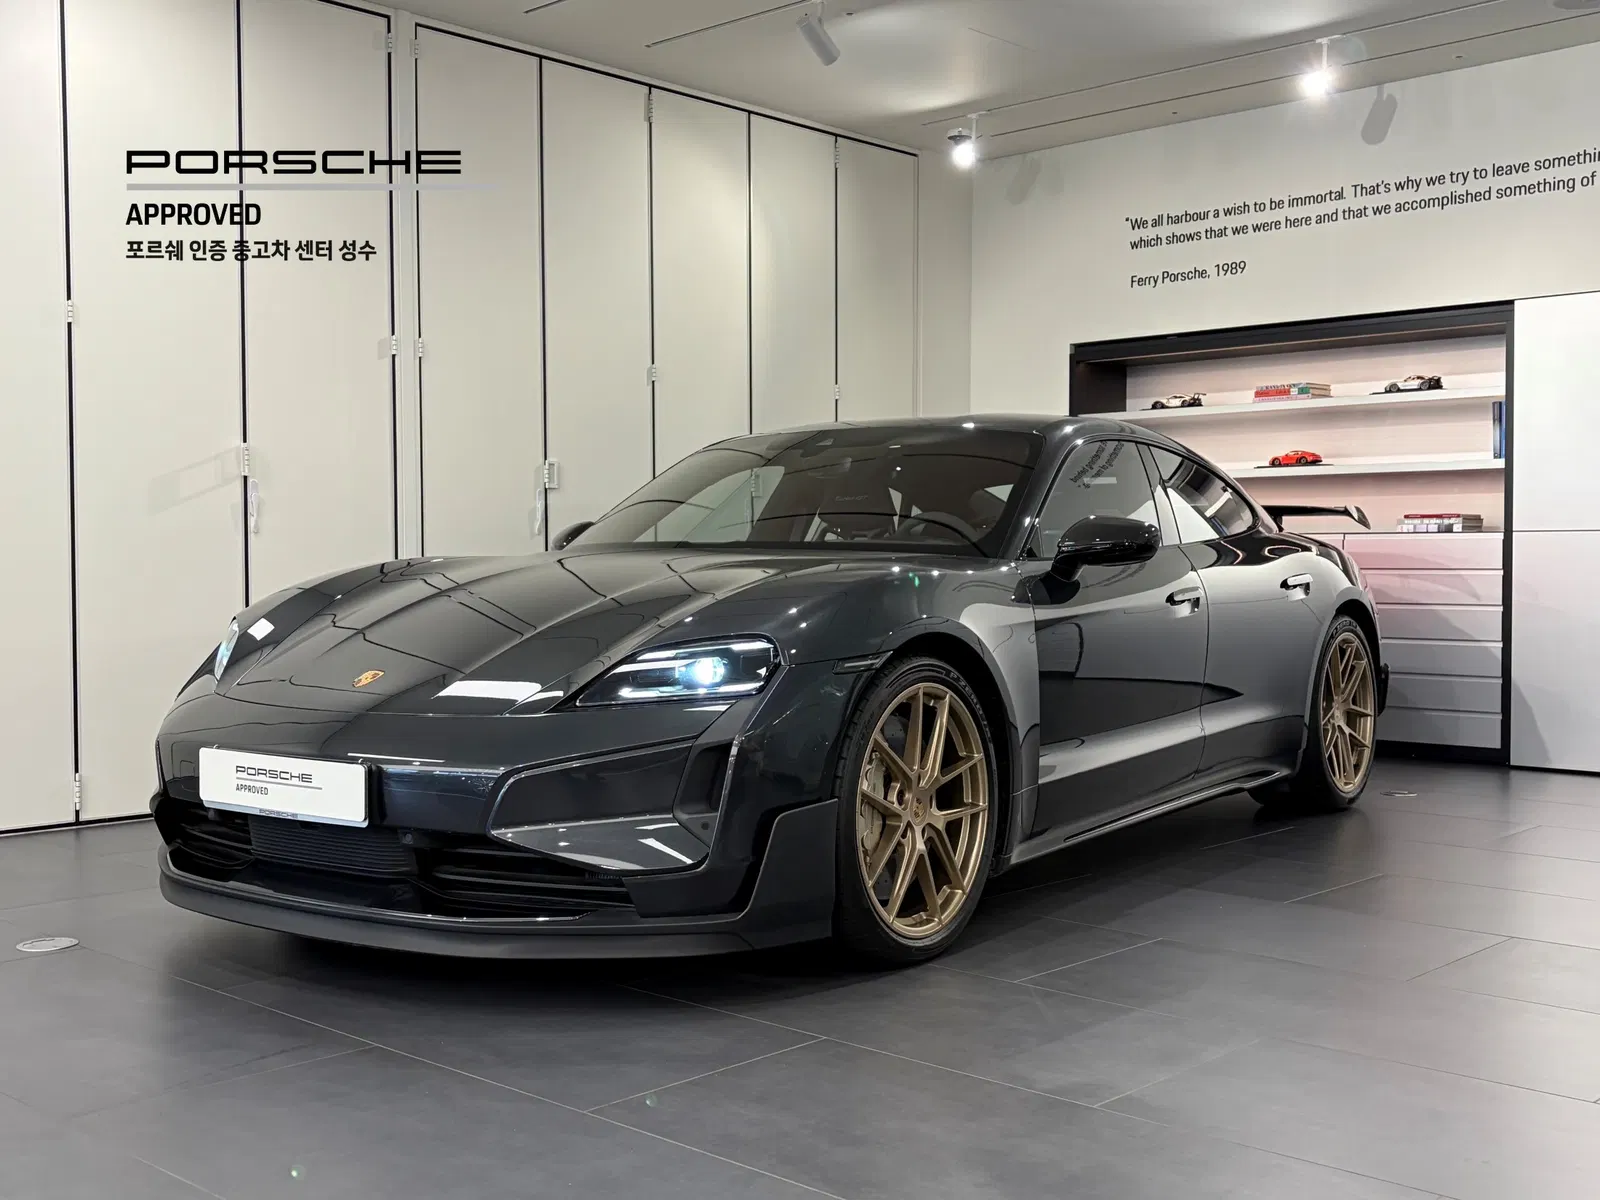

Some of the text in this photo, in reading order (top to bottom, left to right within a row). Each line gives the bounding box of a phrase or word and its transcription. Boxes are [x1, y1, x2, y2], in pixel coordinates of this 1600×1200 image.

[126, 150, 461, 174] PORSCHE
[1151, 213, 1164, 228] all
[1166, 210, 1211, 225] harbour
[1213, 208, 1220, 218] a
[1223, 201, 1250, 217] wish
[1253, 201, 1266, 213] to
[1269, 198, 1285, 211] be
[1288, 186, 1346, 208] immortal.
[1394, 176, 1422, 192] why
[1425, 174, 1446, 187] we
[1449, 171, 1470, 185] try
[1473, 167, 1488, 180] to
[1492, 163, 1530, 177] leave
[126, 203, 262, 226] APPROVED
[1130, 171, 1597, 250] which shows that we were here and that we accomplished something of
[126, 240, 377, 262] 포르쉐 인증 중고차 센터 성수
[1130, 260, 1247, 289] Ferry Porsche, 1989
[235, 765, 313, 784] PORSCHE
[235, 783, 269, 796] APPROVED
[259, 808, 298, 818] PORSCHE
